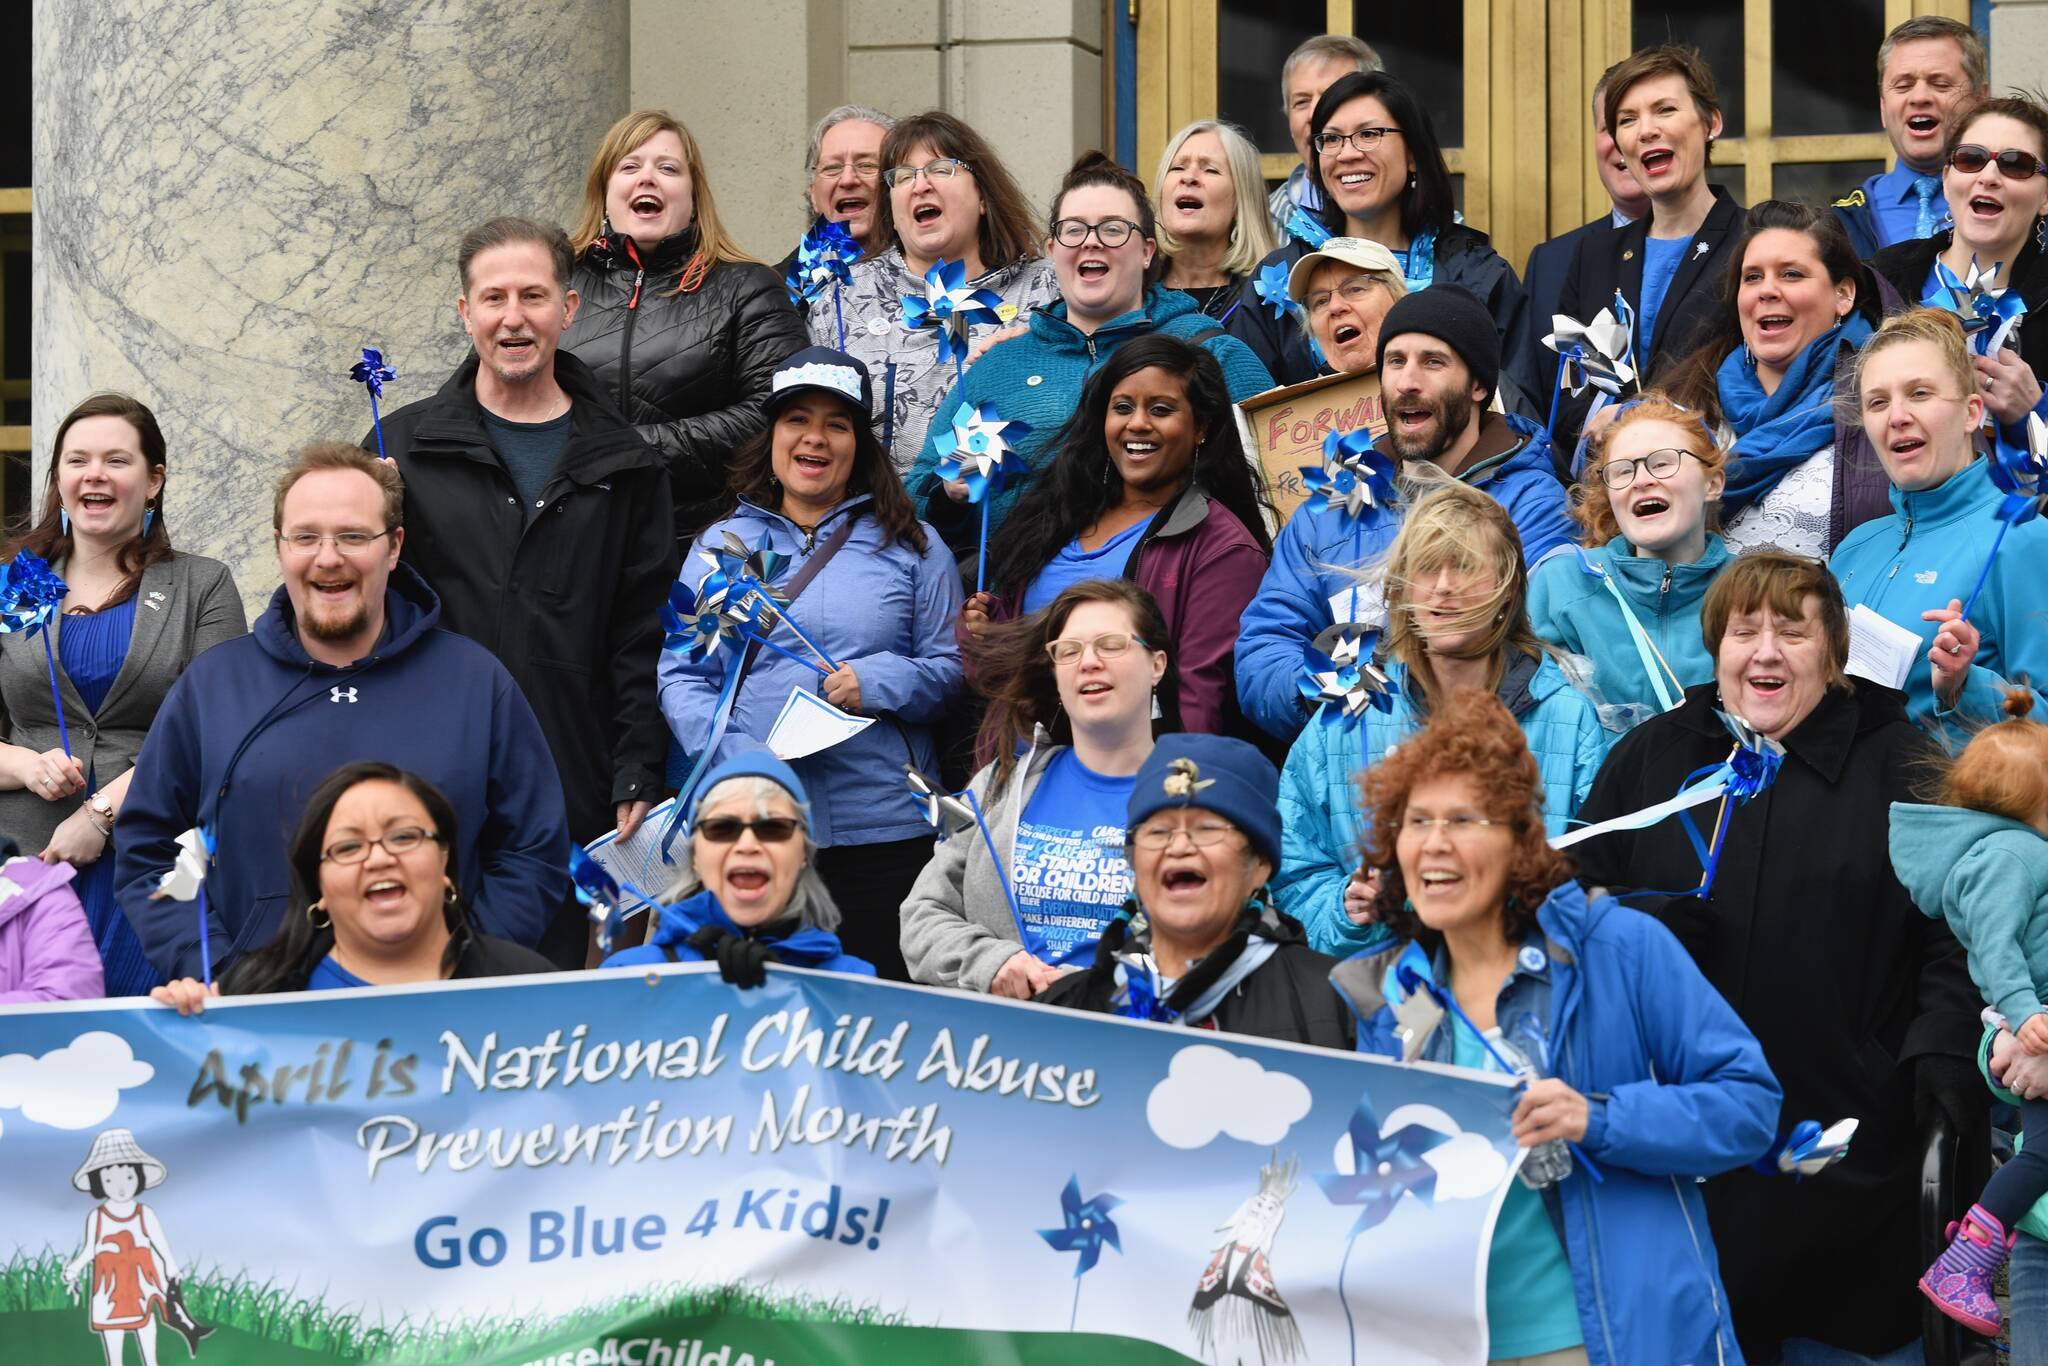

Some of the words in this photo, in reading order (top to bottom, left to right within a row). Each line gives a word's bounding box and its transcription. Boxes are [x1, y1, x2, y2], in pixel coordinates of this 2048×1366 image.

[1043, 842, 1081, 859] CARE
[1036, 853, 1097, 874] STAND
[1098, 857, 1128, 876] UP
[1013, 865, 1041, 885] OR
[1043, 869, 1135, 895] CHILDREN
[1018, 883, 1053, 899] EXCUSE
[1053, 887, 1073, 901] FOR
[1072, 890, 1100, 905] CHILD
[1020, 896, 1041, 906] BELIEVE
[1043, 901, 1069, 916] EVERY
[1069, 904, 1092, 918] CHILD
[1021, 911, 1042, 924] MAKE
[1043, 915, 1050, 925] A
[1050, 915, 1098, 930] DIFFERENCE
[1039, 925, 1088, 942] PROTECT
[1046, 940, 1073, 953] SHARE
[187, 1041, 351, 1125] April
[365, 1037, 419, 1100] is
[439, 1013, 729, 1095] National
[739, 1006, 911, 1076] Child
[916, 1027, 1102, 1108] Abuse
[356, 1098, 734, 1181] Prevention
[748, 1084, 954, 1166] Month
[414, 1215, 508, 1269] Go
[528, 1205, 668, 1263] Blue
[684, 1201, 719, 1239] 4
[734, 1183, 891, 1251] Kids!
